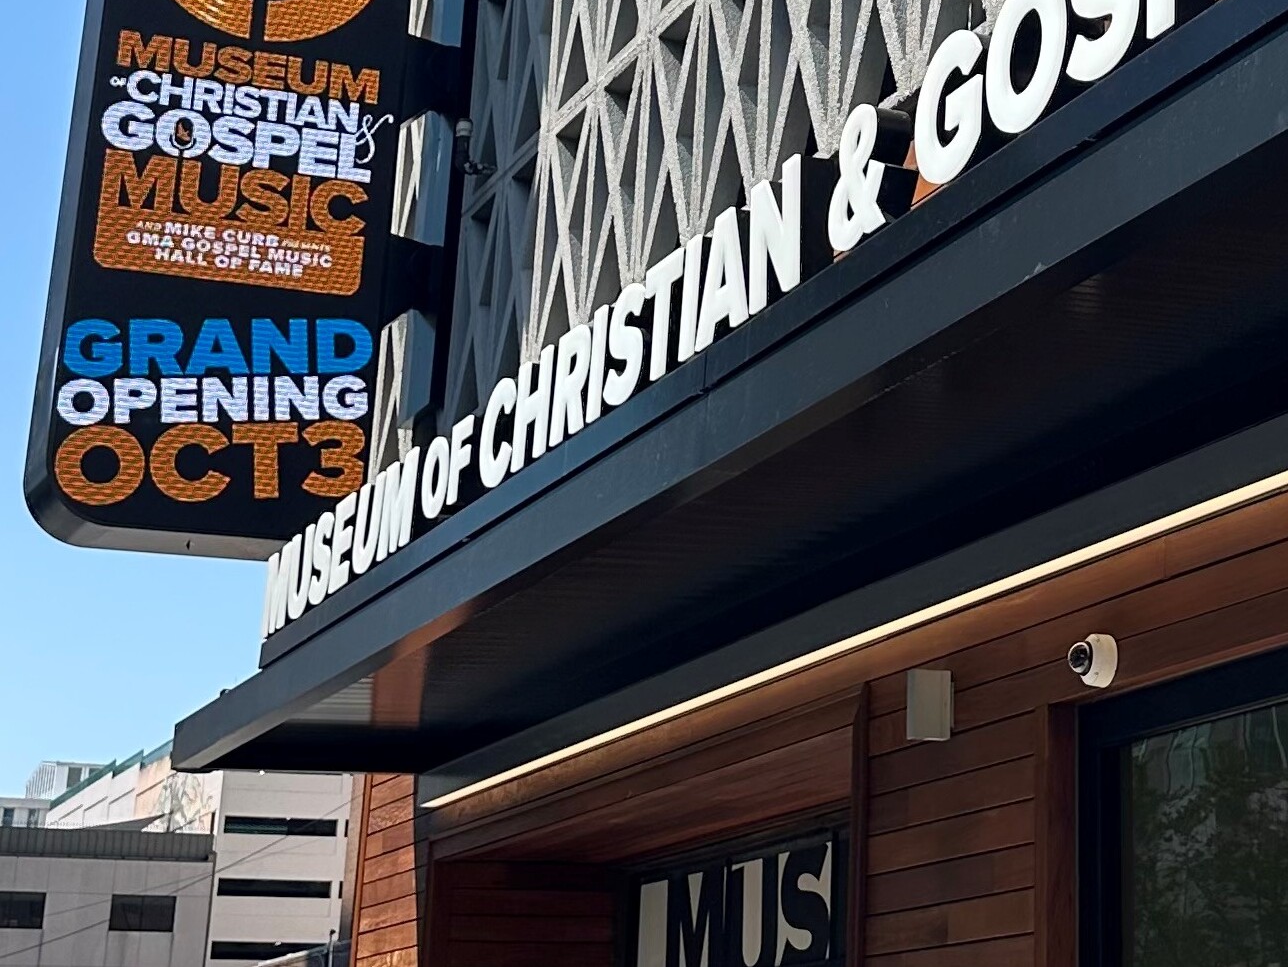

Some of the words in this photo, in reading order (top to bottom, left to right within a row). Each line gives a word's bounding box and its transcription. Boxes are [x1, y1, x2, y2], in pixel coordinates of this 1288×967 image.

[116, 30, 380, 104] MUSEUM
[101, 100, 372, 183] GOSPEL
[126, 69, 360, 131] CHRISTIAN
[354, 113, 394, 164] &
[98, 148, 369, 235] MUSIC
[154, 246, 208, 267] HALL
[213, 253, 243, 270] OF
[248, 258, 304, 278] FAME
[164, 220, 216, 239] MIKE
[222, 229, 279, 247] CURB
[181, 236, 262, 259] GOSPEL
[268, 246, 334, 268] MUSIC
[63, 318, 373, 378] GRAND
[264, 446, 421, 639] MUSEUM
[421, 414, 476, 519] OF
[479, 153, 801, 489] CHRISTIAN
[828, 103, 886, 252] &
[57, 375, 369, 426] OPENING
